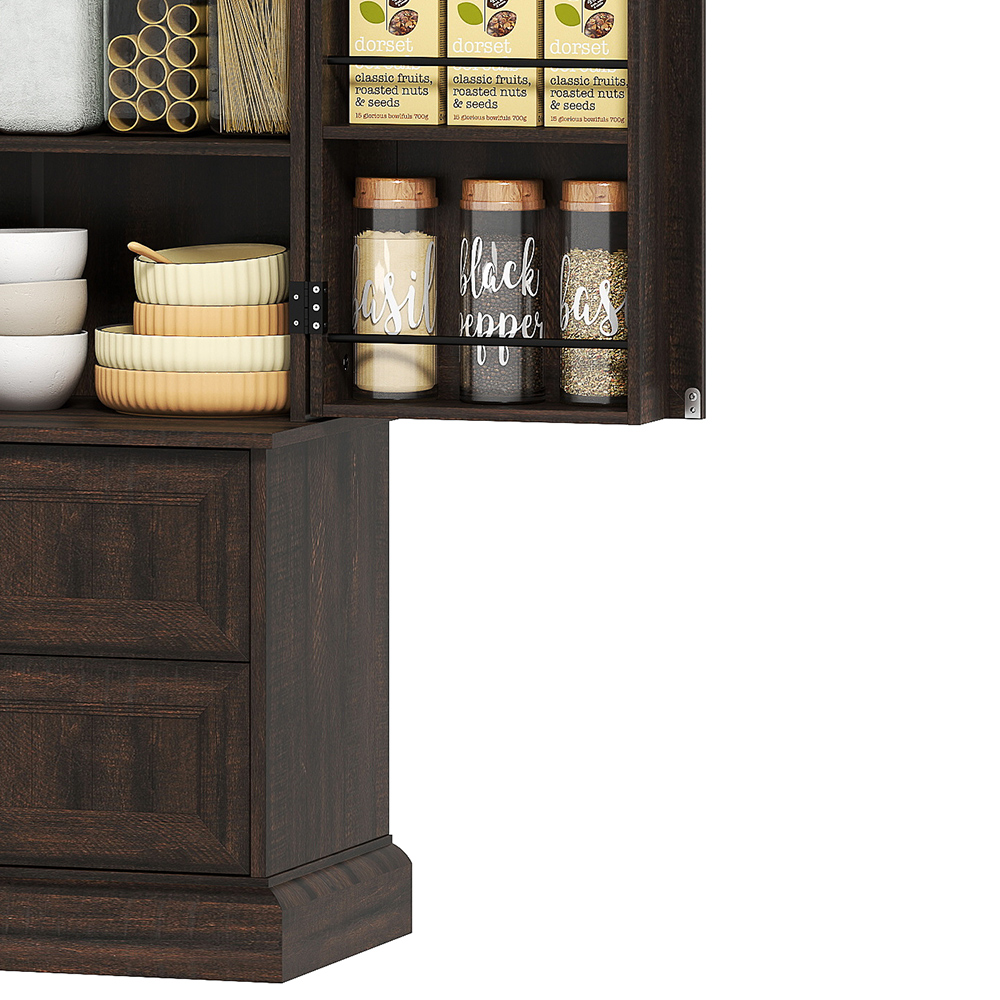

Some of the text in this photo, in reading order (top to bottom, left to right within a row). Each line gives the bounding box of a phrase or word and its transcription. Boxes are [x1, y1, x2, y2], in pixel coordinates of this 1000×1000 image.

[354, 36, 413, 52] dorset
[452, 37, 512, 54] dorset
[549, 39, 610, 55] dorset
[355, 72, 433, 85] classic fruits,
[453, 74, 531, 86] classic fruits,
[550, 76, 628, 88] classic fruits,
[355, 85, 429, 96] roasted nuts
[453, 87, 527, 98] roasted nuts
[550, 88, 625, 99] roasted nuts
[355, 97, 400, 107] & seeds
[453, 98, 498, 109] & seeds
[550, 100, 596, 111] & seeds
[363, 112, 387, 120] glorious
[459, 236, 540, 299] black
[559, 254, 628, 337] bas
